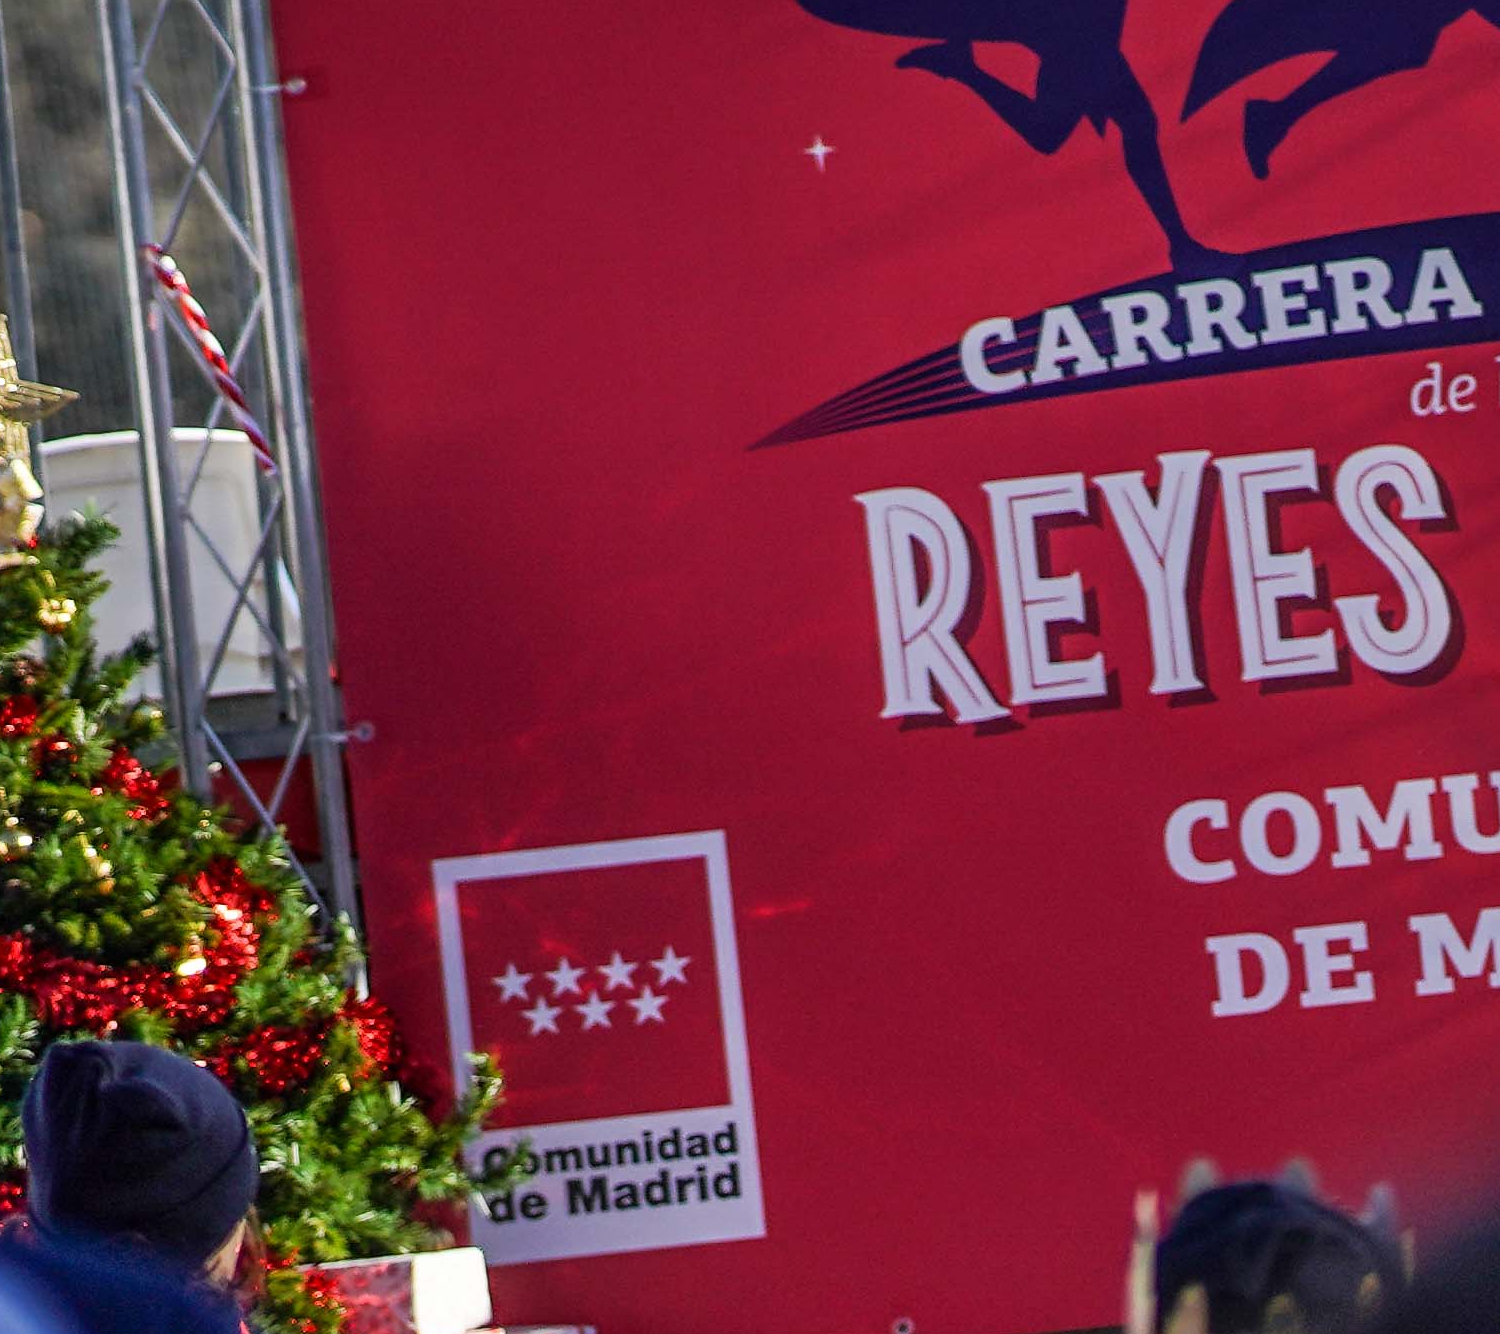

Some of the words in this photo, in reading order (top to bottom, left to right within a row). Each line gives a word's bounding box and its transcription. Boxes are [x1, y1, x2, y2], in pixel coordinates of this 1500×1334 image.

[959, 247, 1483, 394] CARRERA
[1410, 363, 1478, 417] de
[853, 444, 1454, 725] REYES
[1205, 921, 1375, 1018] DE
[488, 1184, 549, 1226] de
[566, 1162, 742, 1216] Madrid
